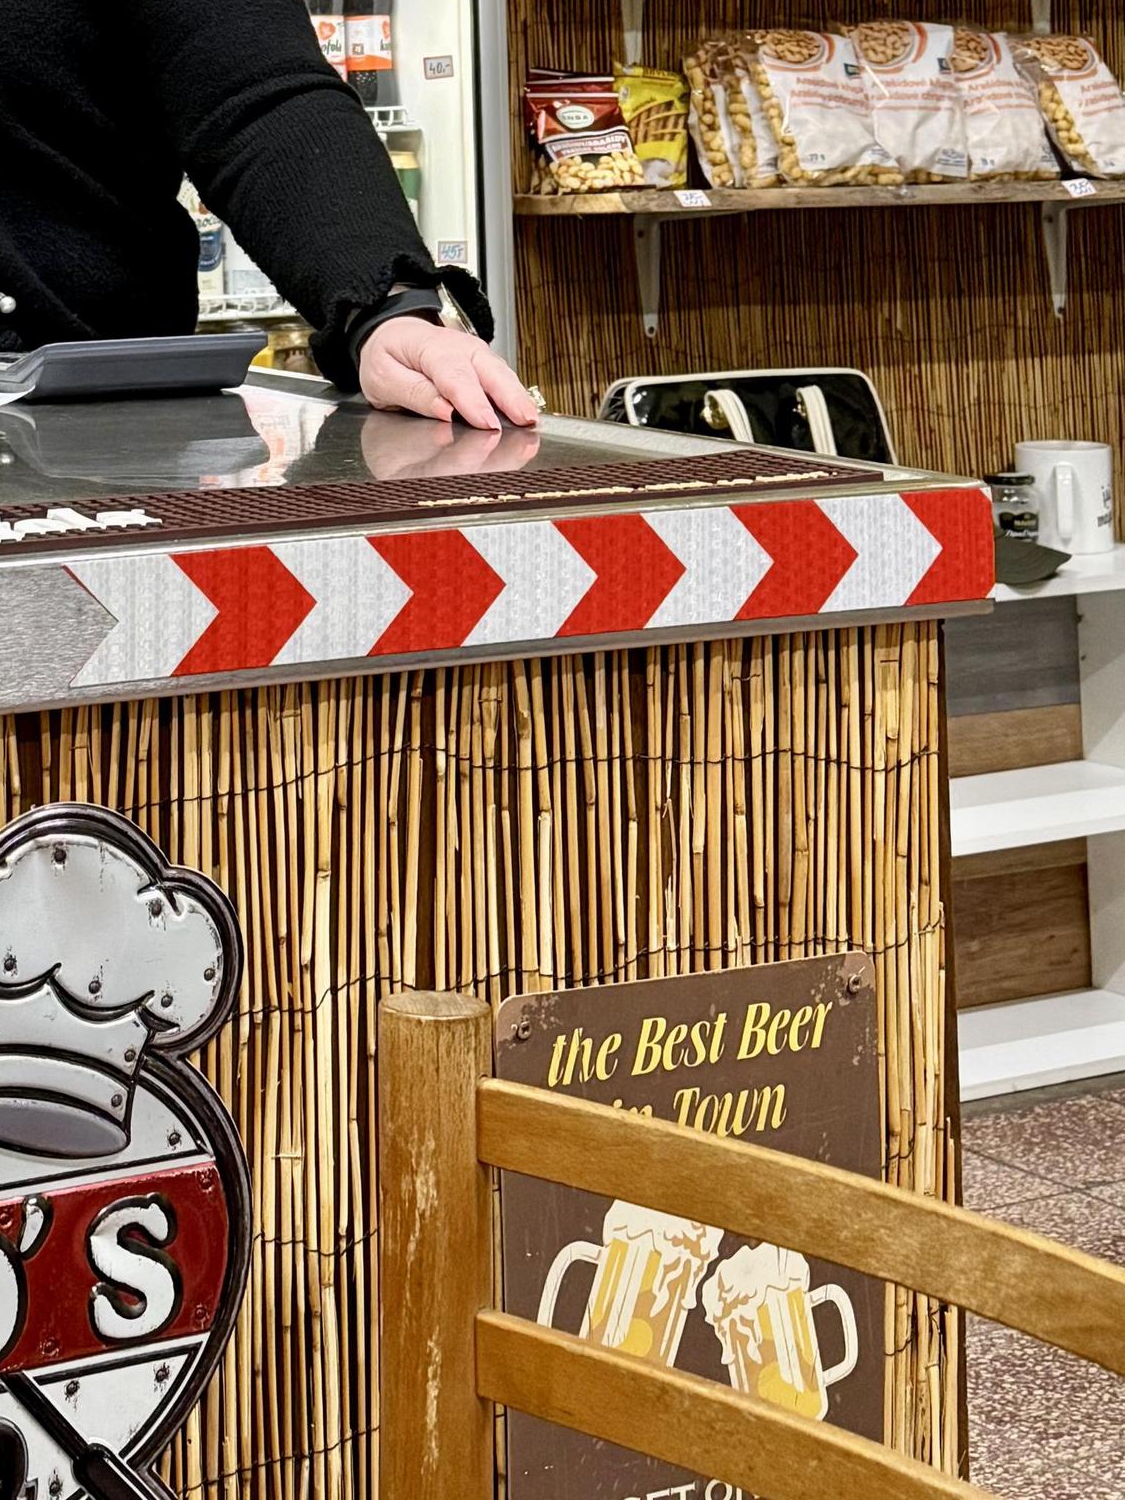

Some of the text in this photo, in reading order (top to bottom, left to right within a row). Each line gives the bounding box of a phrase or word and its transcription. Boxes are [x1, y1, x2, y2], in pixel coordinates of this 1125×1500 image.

[547, 1001, 833, 1088] the Best Beer
[673, 1083, 787, 1137] Town
